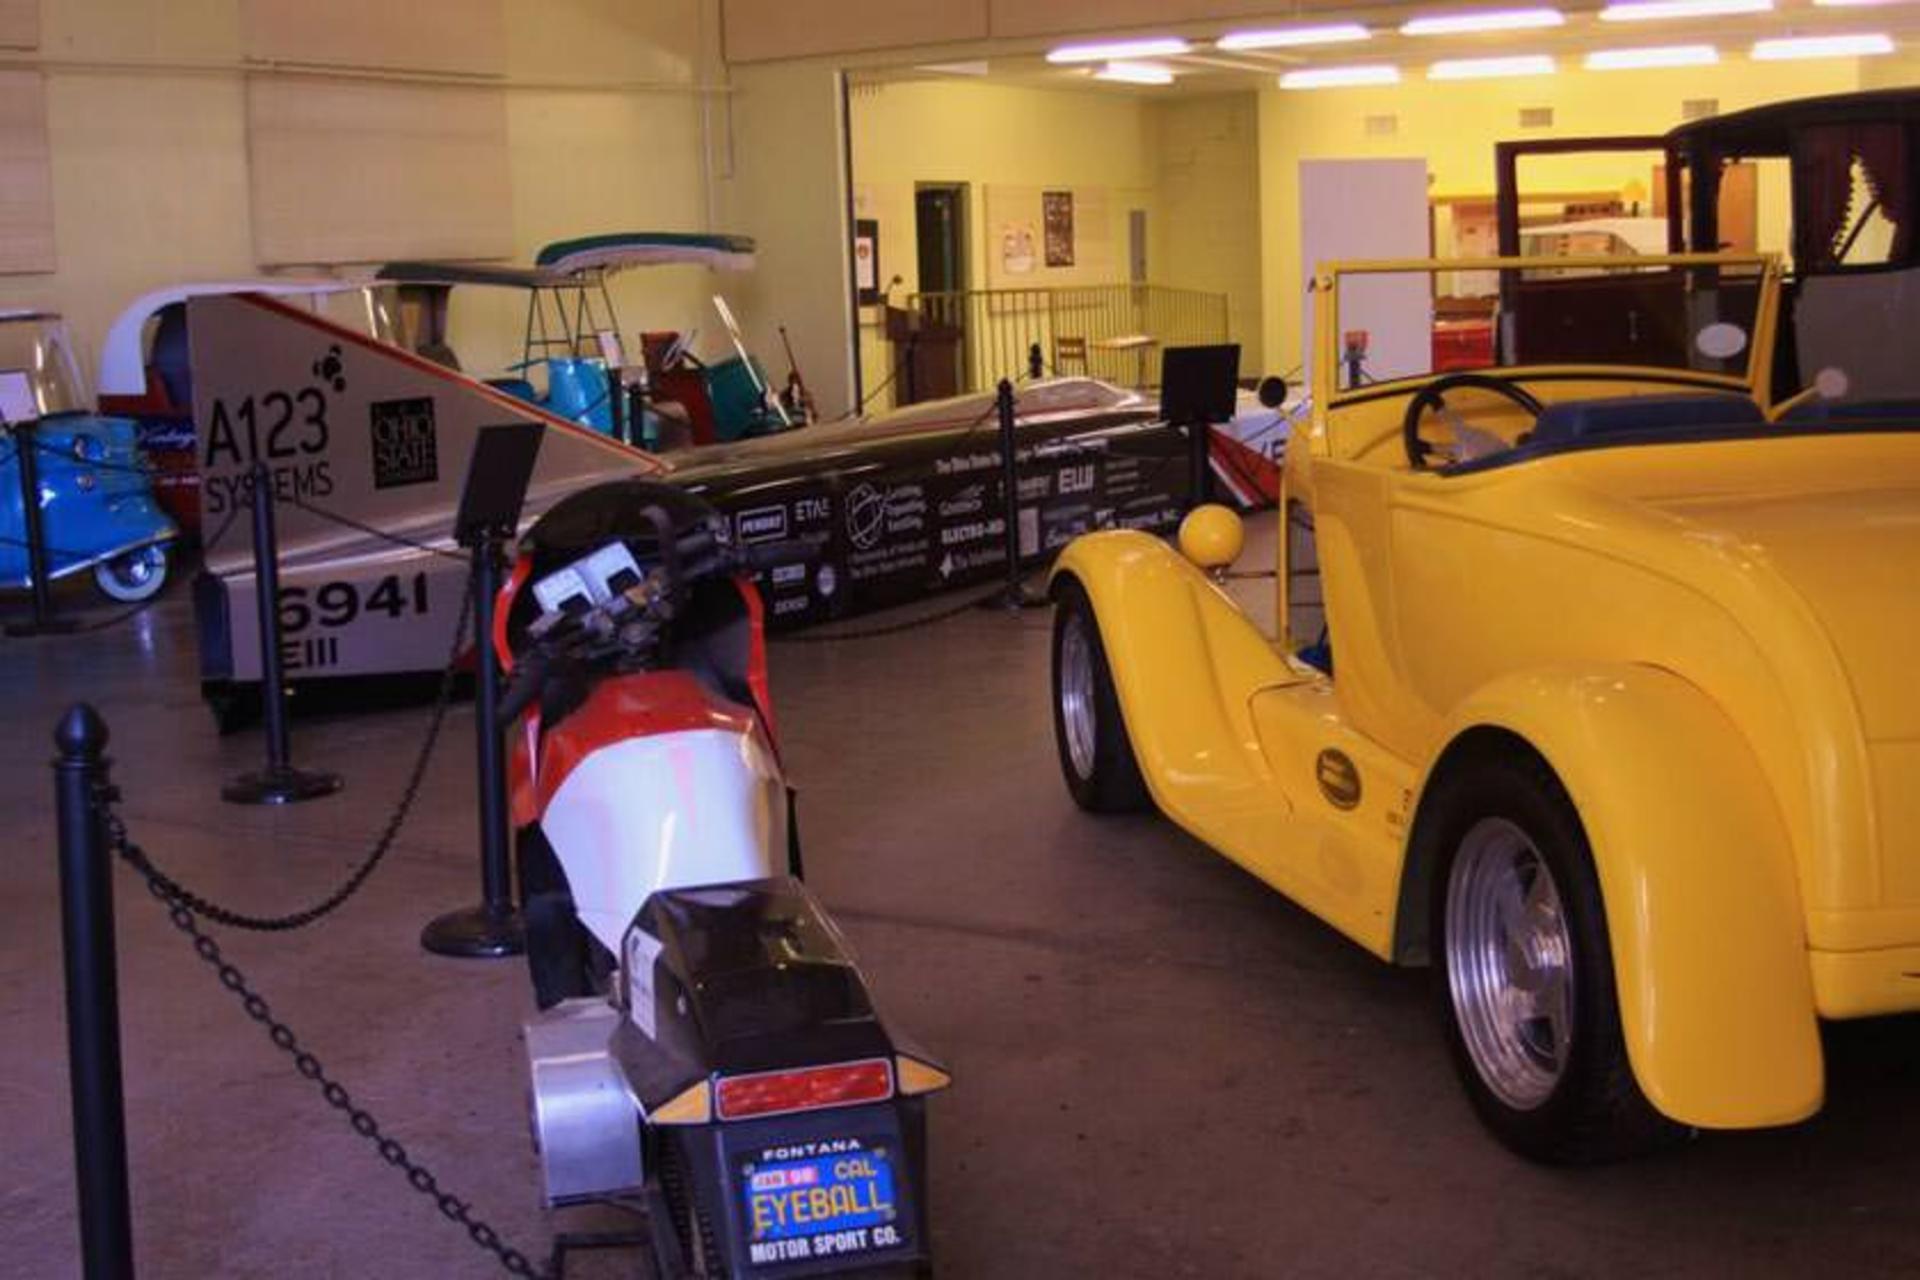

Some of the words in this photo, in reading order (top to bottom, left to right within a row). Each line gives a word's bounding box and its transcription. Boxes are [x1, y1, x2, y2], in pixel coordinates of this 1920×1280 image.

[206, 388, 328, 467] A123
[206, 461, 333, 513] SYSEMS
[1058, 464, 1094, 493] EWI
[762, 1139, 860, 1161] FONTANA
[834, 1159, 877, 1179] CAL
[753, 1181, 893, 1229] EYEBALL
[751, 1237, 809, 1263] MOTOR
[814, 1230, 867, 1255] SPORT
[873, 1226, 900, 1246] CO.
